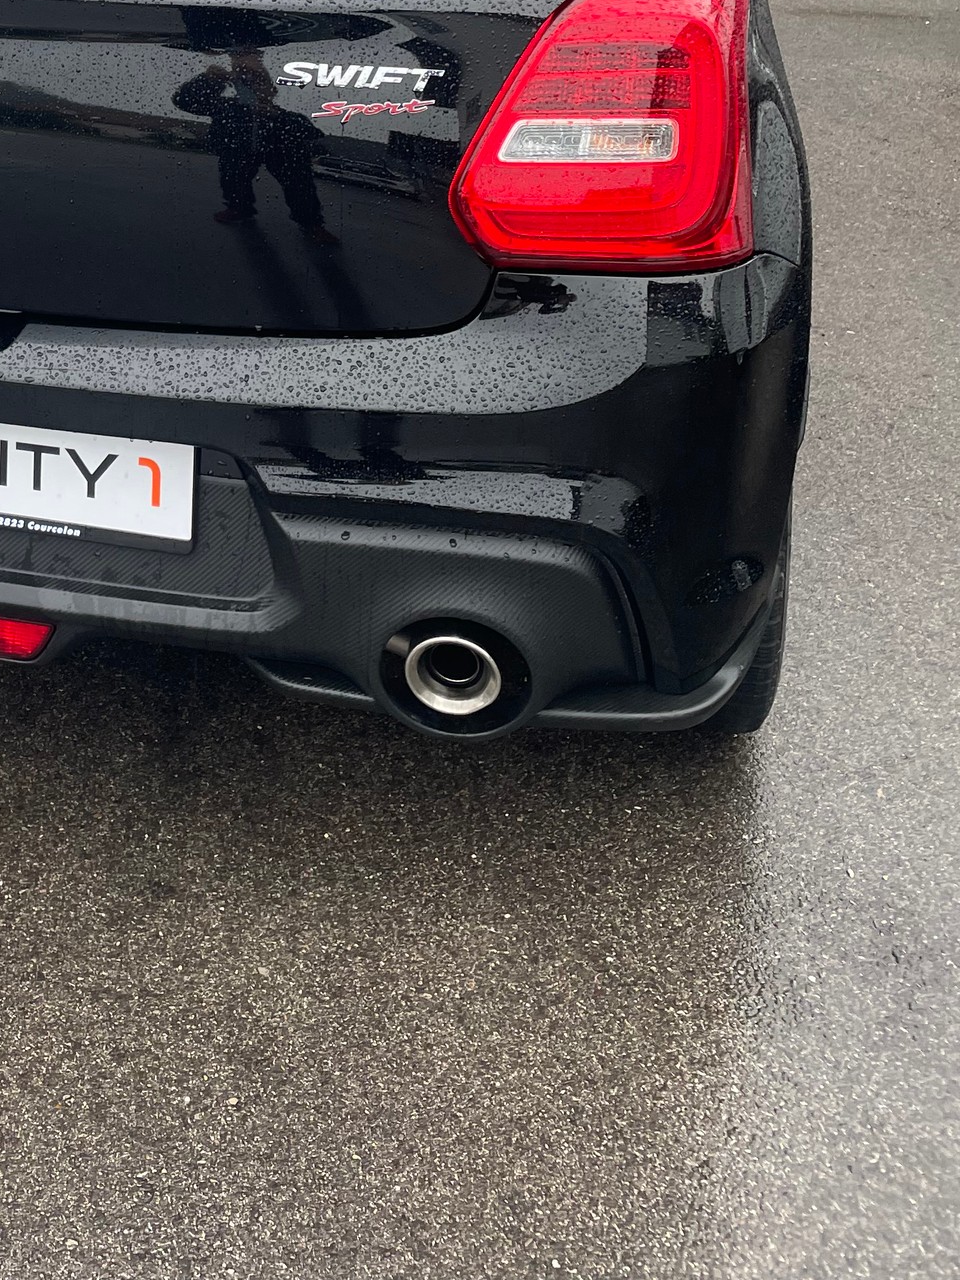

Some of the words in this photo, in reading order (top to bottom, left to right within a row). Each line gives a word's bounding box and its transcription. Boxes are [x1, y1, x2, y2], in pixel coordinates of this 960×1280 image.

[276, 61, 446, 92] SWIFT
[311, 99, 436, 124] Sport
[137, 456, 162, 507] 1
[27, 520, 81, 537] Courcelon
